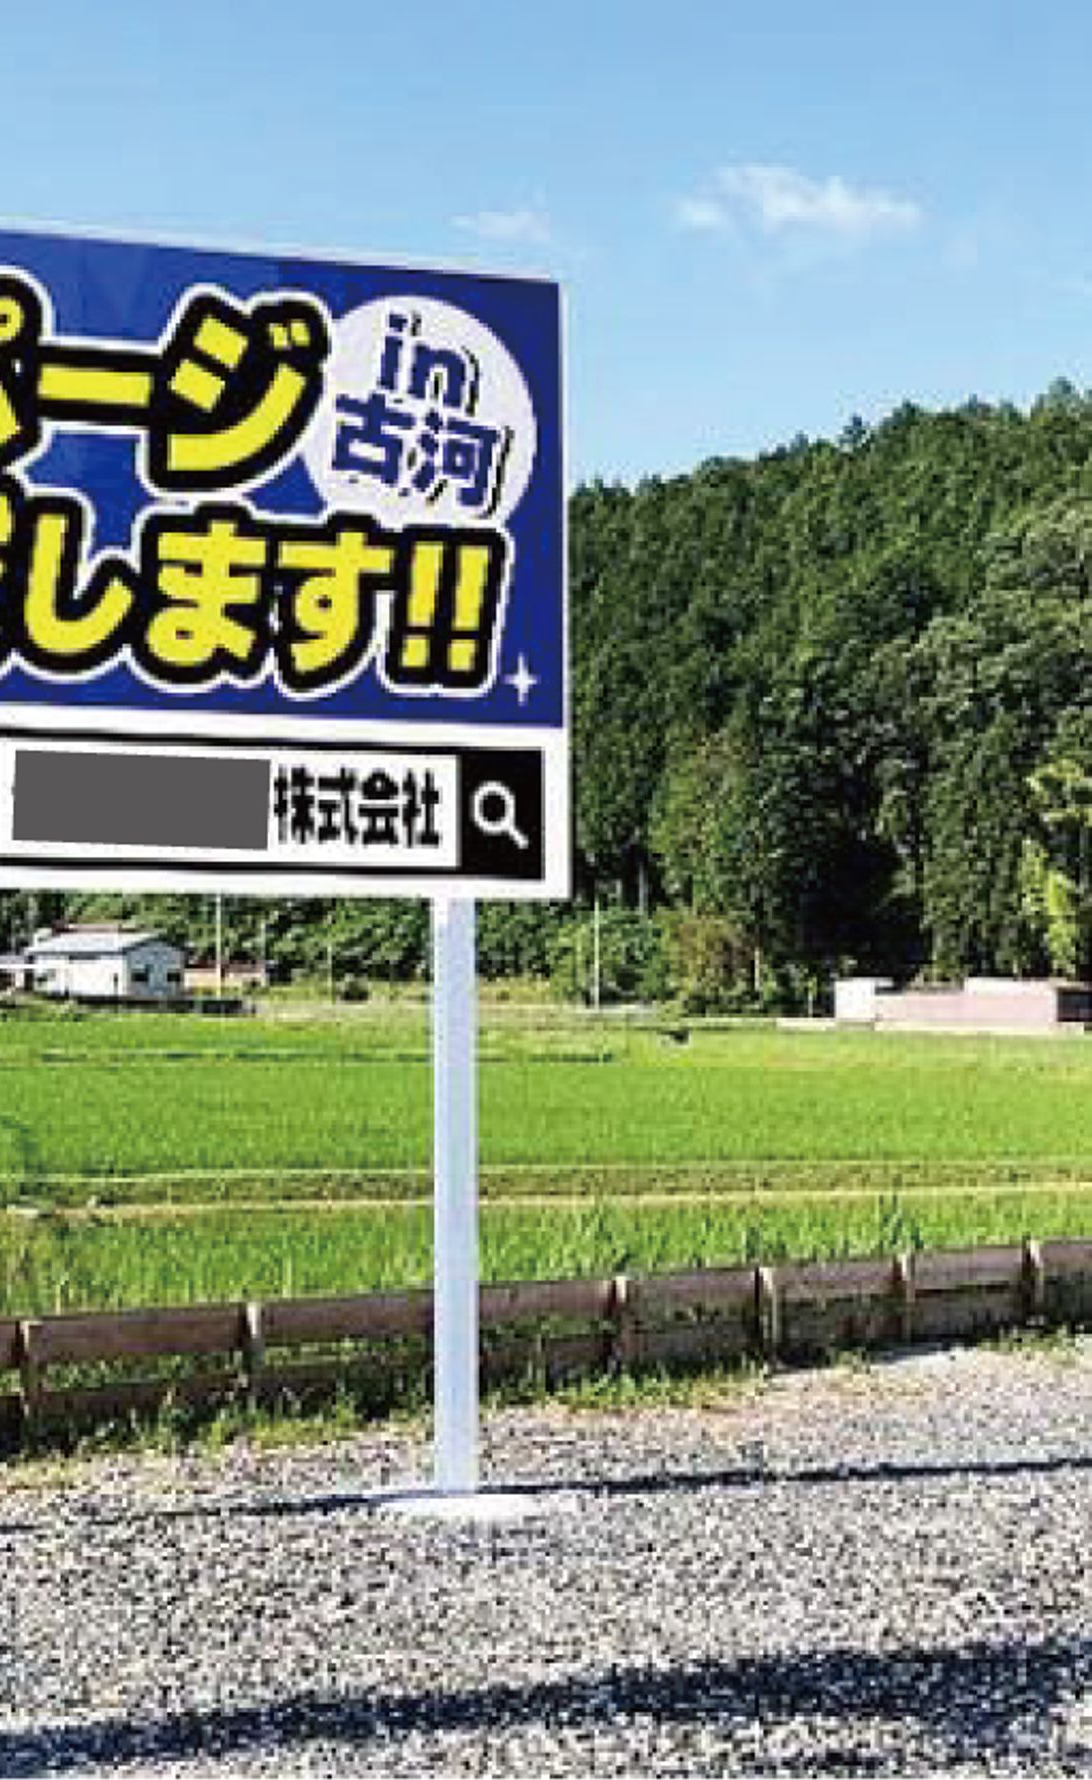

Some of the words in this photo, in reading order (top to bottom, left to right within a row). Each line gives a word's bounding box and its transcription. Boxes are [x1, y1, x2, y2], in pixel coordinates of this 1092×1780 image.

[379, 313, 470, 409] in
[332, 393, 502, 507] 古河
[273, 766, 441, 849] 株式会社
